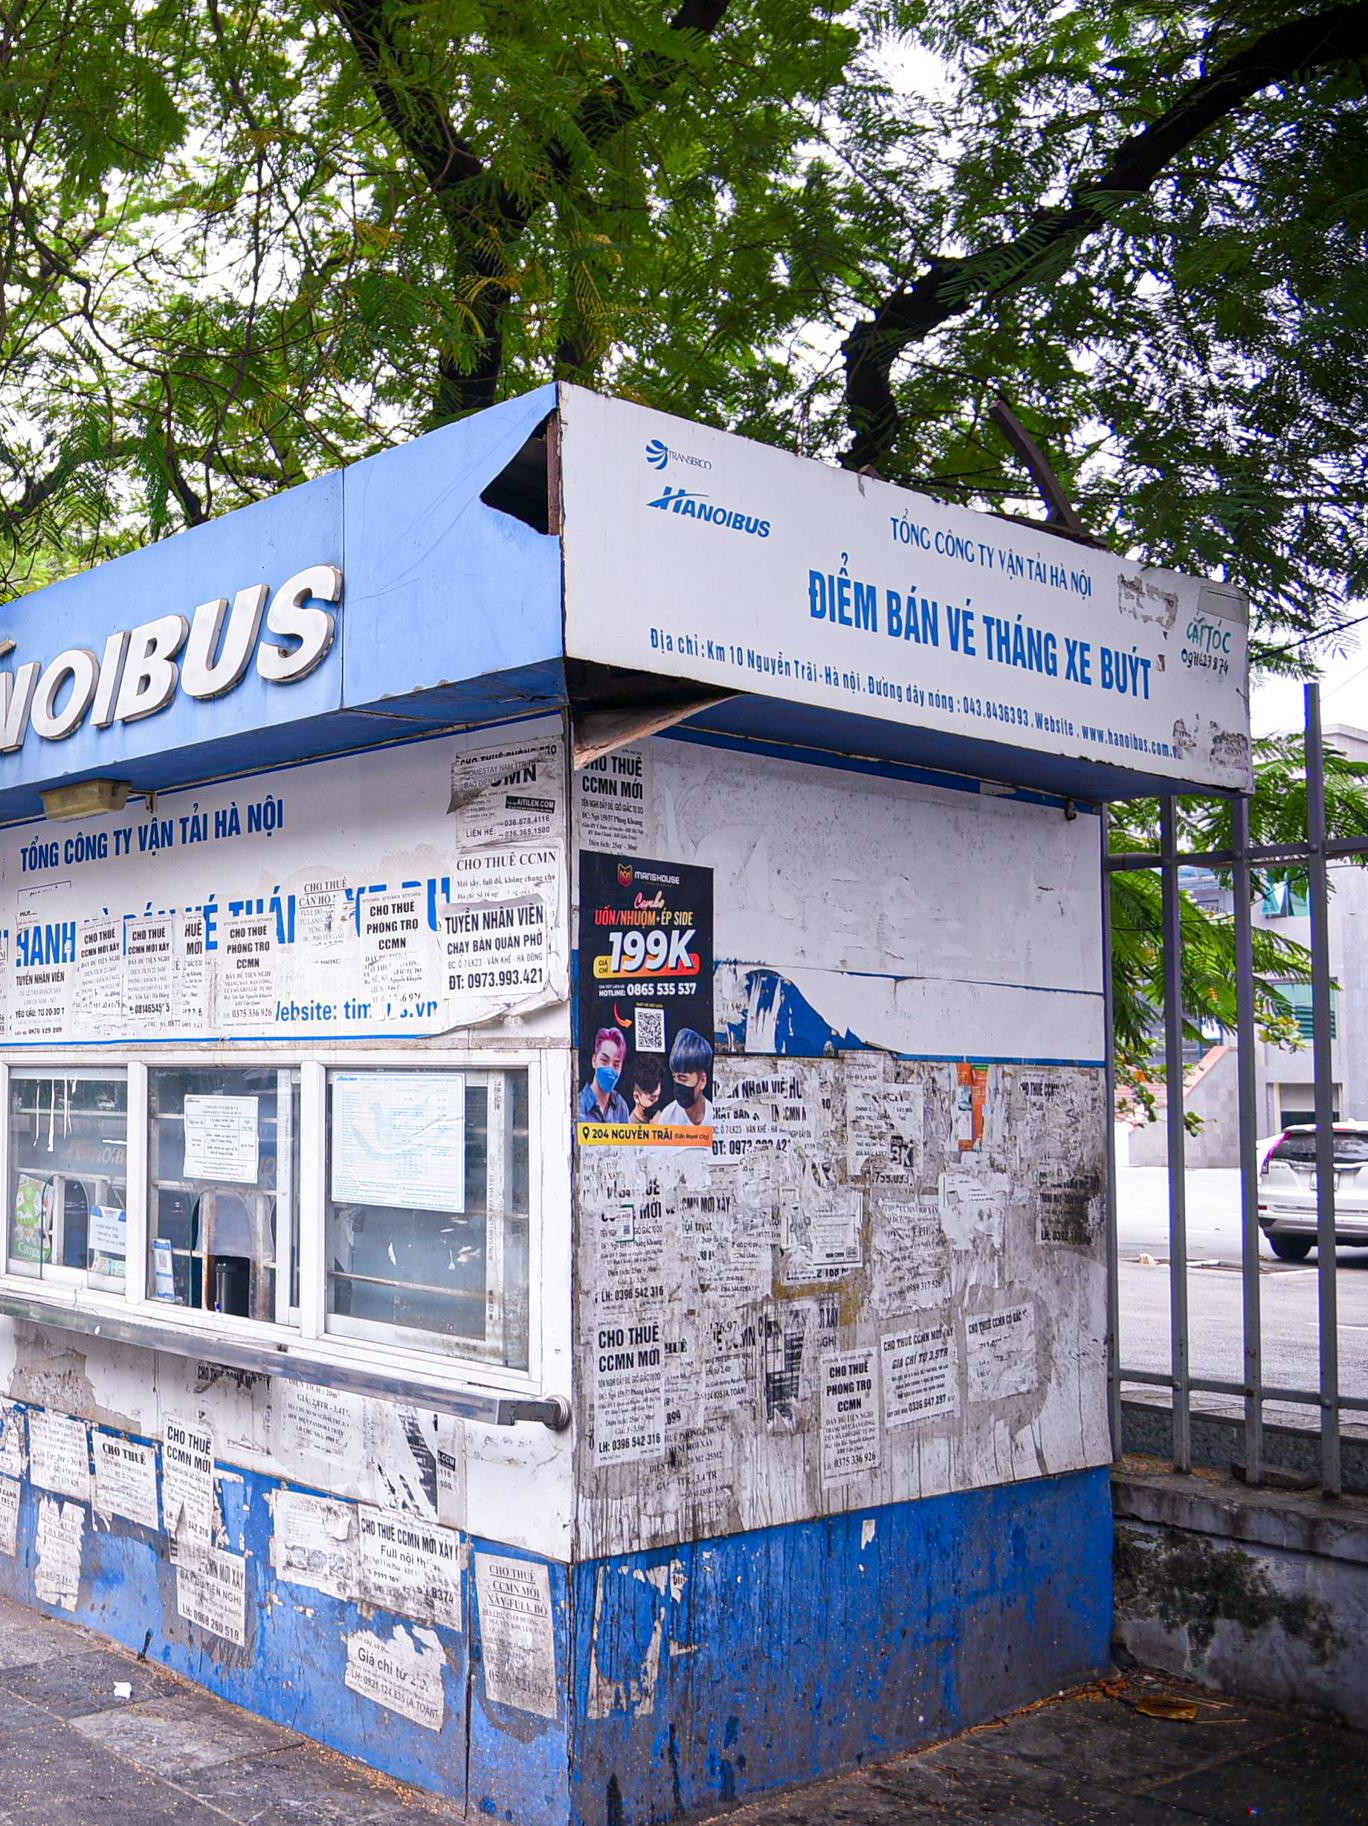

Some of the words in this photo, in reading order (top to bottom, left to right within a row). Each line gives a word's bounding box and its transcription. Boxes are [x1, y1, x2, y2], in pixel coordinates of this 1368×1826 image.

[668, 449, 711, 470] TRANSERCO
[646, 485, 771, 538] HANOIBUS
[890, 508, 931, 550] TỔNG
[935, 529, 975, 563] CÔNG
[978, 544, 993, 569] TY
[998, 550, 1024, 580] VẬN
[1027, 553, 1046, 584] TẢI
[1050, 555, 1067, 586] HÀ
[1071, 569, 1092, 600] NỘI
[808, 552, 878, 632] ĐIỂM
[886, 585, 939, 647] BÁN
[946, 598, 976, 657] VÉ
[983, 613, 1057, 677] THÁNG
[1064, 637, 1092, 686] XE
[1100, 646, 1151, 700] BUÝT
[650, 627, 673, 654] Địa
[730, 645, 744, 666] 10
[747, 649, 791, 677] Nguyễn
[868, 675, 903, 704] Đường
[906, 683, 925, 708] dây
[928, 688, 954, 713] nóng
[963, 695, 1029, 726] 043.8436393
[1034, 712, 1074, 736] Website
[611, 756, 642, 778] THUÊ
[582, 775, 617, 797] CCMN
[620, 779, 643, 800] MỚI
[21, 836, 59, 872] TỔNG
[64, 832, 108, 865] CÔNG
[113, 828, 132, 856] TY
[138, 817, 174, 856] VẬN
[180, 802, 208, 844] TẢI
[215, 802, 241, 838] HÀ
[248, 794, 284, 838] NỘI
[456, 858, 481, 871] CHO
[486, 851, 517, 869] THUÊ
[519, 850, 556, 867] CCMN
[370, 904, 389, 917] CHO
[391, 899, 415, 914] THUÊ
[483, 905, 514, 931] NHÂN
[519, 902, 544, 926] VIÊN
[674, 911, 694, 926] SIDE
[84, 932, 98, 944] CHO
[99, 928, 116, 942] THUÊ
[132, 931, 147, 941] CHO
[148, 927, 166, 939] THUÊ
[230, 928, 246, 939] CHO
[247, 925, 268, 937] THUÊ
[81, 946, 97, 958] CCMN
[128, 945, 145, 955] CCMN
[378, 937, 406, 951] CCMN
[447, 941, 470, 957] CHẠY
[494, 932, 520, 949] QUÁN
[609, 929, 696, 973] 199K
[236, 957, 260, 969] CCMN
[449, 974, 464, 990] ĐT:
[468, 967, 543, 989] 0973.993.421
[598, 989, 626, 997] HOTLINE:
[627, 983, 654, 996] 0865
[656, 983, 675, 995] 535
[678, 982, 696, 995] 537
[275, 999, 337, 1022] ebsite:
[592, 1129, 609, 1139] 204
[611, 1126, 650, 1140] NGUYỄN
[652, 1128, 673, 1140] TRÃI
[598, 1328, 624, 1349] CHO
[628, 1321, 660, 1346] THUÊ
[883, 1339, 895, 1351] CHO
[896, 1334, 912, 1348] THUÊ
[913, 1333, 930, 1345] CCMN
[599, 1351, 634, 1373] CCMN
[638, 1344, 660, 1367] MỚI
[829, 1365, 847, 1378] CHO
[848, 1359, 869, 1376] THUÊ
[837, 1398, 862, 1412] CCMN
[166, 1426, 186, 1446] CHO
[188, 1432, 211, 1455] THUÊ
[598, 1441, 610, 1453] LH:
[612, 1437, 630, 1450] 0396
[632, 1435, 646, 1447] 542
[647, 1433, 660, 1446] 316
[122, 1448, 146, 1465] THUÊ
[166, 1445, 192, 1467] CCMN
[194, 1455, 211, 1475] MỚI
[361, 1517, 375, 1536] CHO
[377, 1522, 395, 1543] THUÊ
[398, 1528, 420, 1550] CCMN
[422, 1534, 437, 1555] MỚI
[439, 1538, 454, 1560] XÂY
[380, 1543, 397, 1560] Full
[489, 1564, 510, 1578] CHO
[512, 1567, 536, 1583] THUÊ
[492, 1580, 519, 1595] CCMN
[358, 1647, 375, 1667] Giá
[377, 1659, 393, 1676] chỉ
